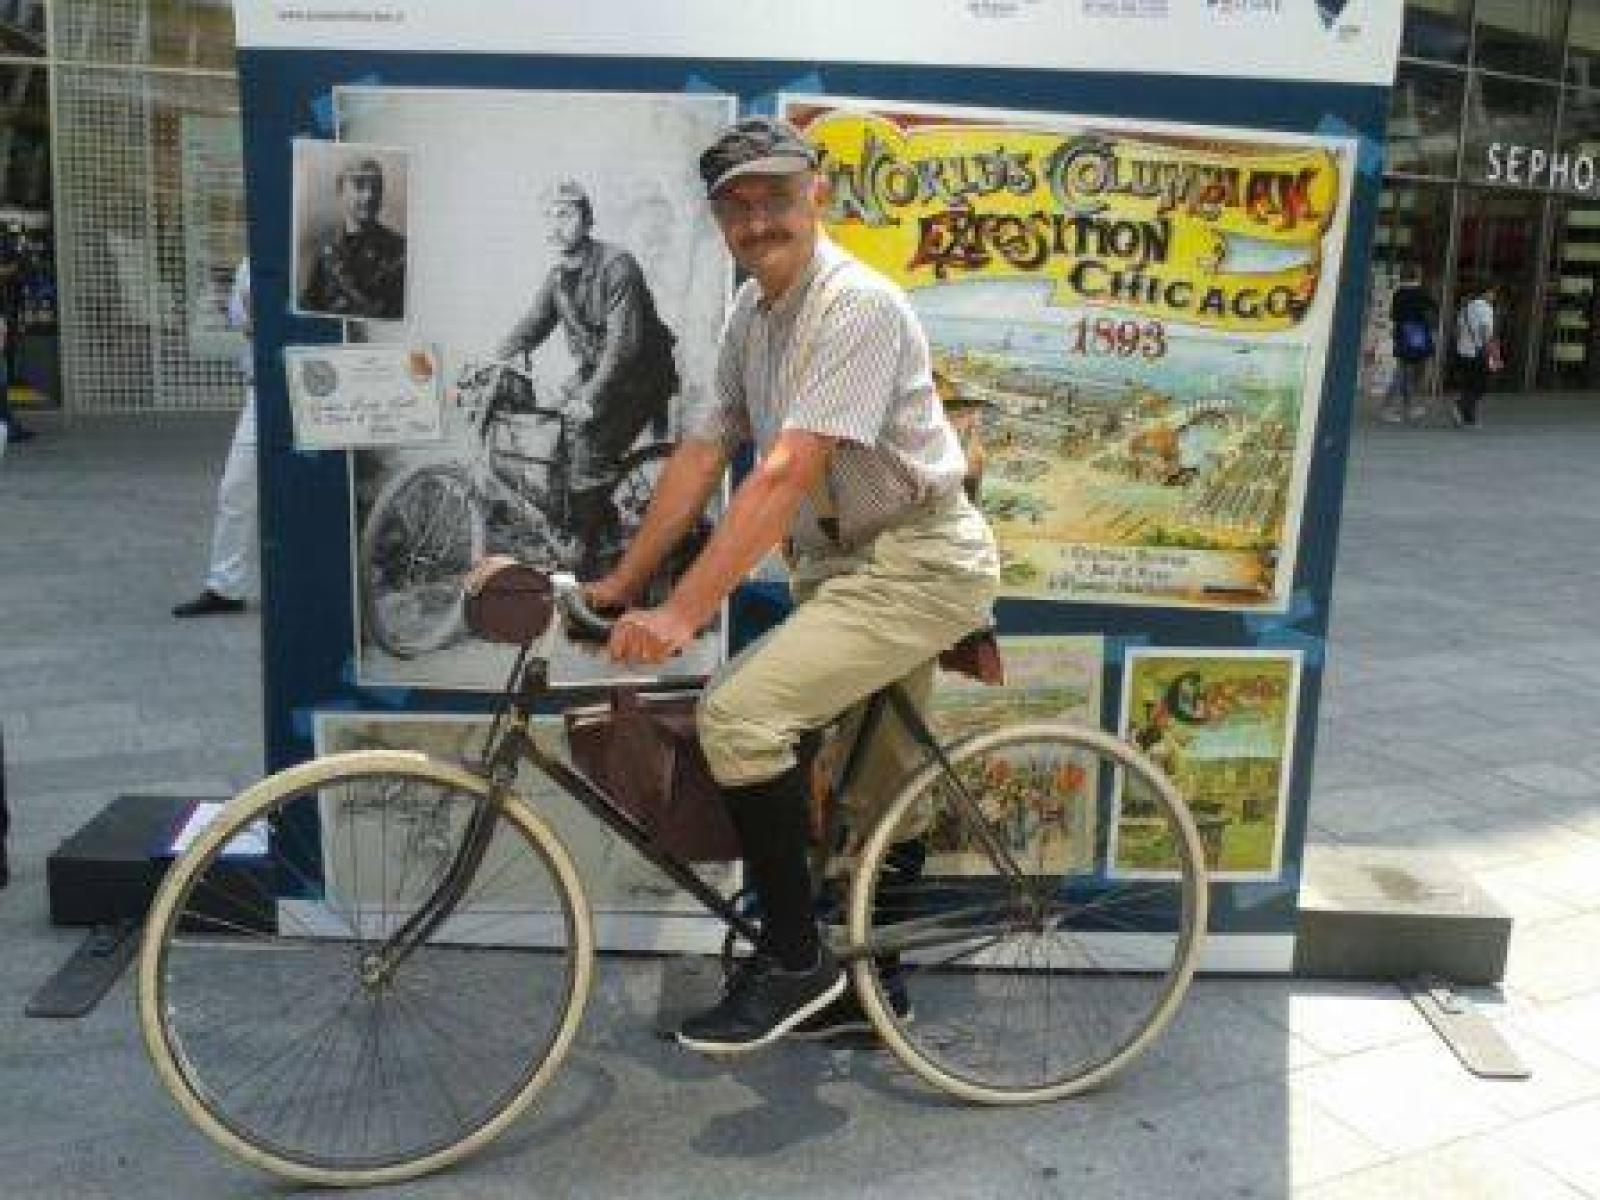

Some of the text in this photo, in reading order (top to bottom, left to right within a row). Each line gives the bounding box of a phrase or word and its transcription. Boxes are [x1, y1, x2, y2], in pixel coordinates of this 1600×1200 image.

[1486, 142, 1600, 193] SEPHO
[1069, 261, 1297, 320] CHICAGO
[1069, 317, 1168, 359] 1893
